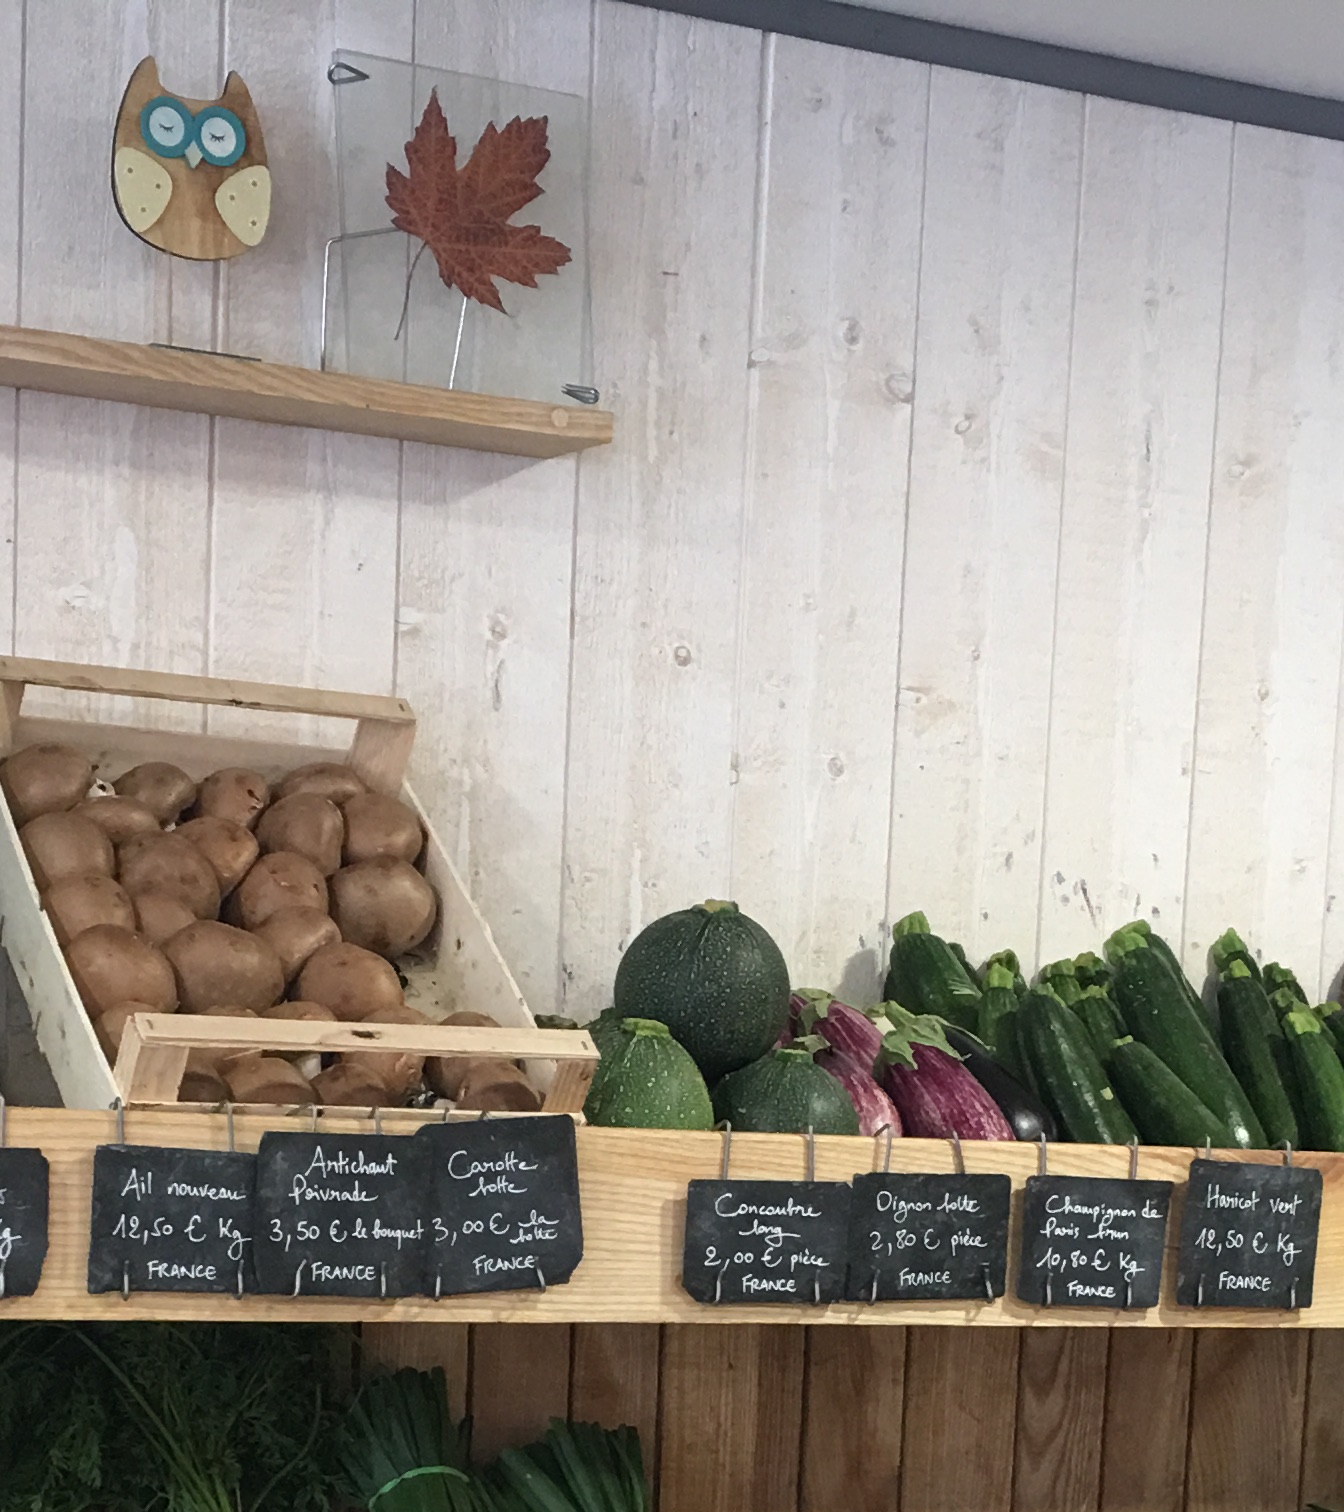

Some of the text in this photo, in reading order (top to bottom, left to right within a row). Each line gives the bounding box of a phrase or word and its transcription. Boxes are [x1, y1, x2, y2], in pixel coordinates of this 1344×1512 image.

[448, 1150, 538, 1179] Carotte
[121, 1168, 246, 1201] Ail nouveau
[289, 1174, 378, 1205] Poivrade
[469, 1177, 527, 1197] botte
[876, 1191, 931, 1223] Oignon
[1045, 1194, 1163, 1225] Champignon de
[1207, 1184, 1260, 1212] Haricot
[519, 1210, 559, 1226] la
[1040, 1218, 1129, 1240] Paris brun
[219, 1217, 252, 1260] Kg
[372, 1219, 424, 1249] bouquet
[510, 1226, 558, 1244] botte
[739, 1219, 801, 1248] long
[951, 1228, 988, 1256] pièce
[791, 1249, 830, 1272] pièce
[1277, 1233, 1302, 1267] Kg
[147, 1260, 217, 1280] FRANCE
[311, 1262, 376, 1281] FRANCE
[473, 1255, 535, 1276] FRANCE
[899, 1267, 952, 1287] FRANCE
[1119, 1252, 1145, 1282] Kg
[742, 1273, 797, 1293] FRANCE
[1067, 1279, 1117, 1299] FRANCE
[1219, 1271, 1272, 1292] FRANCE
